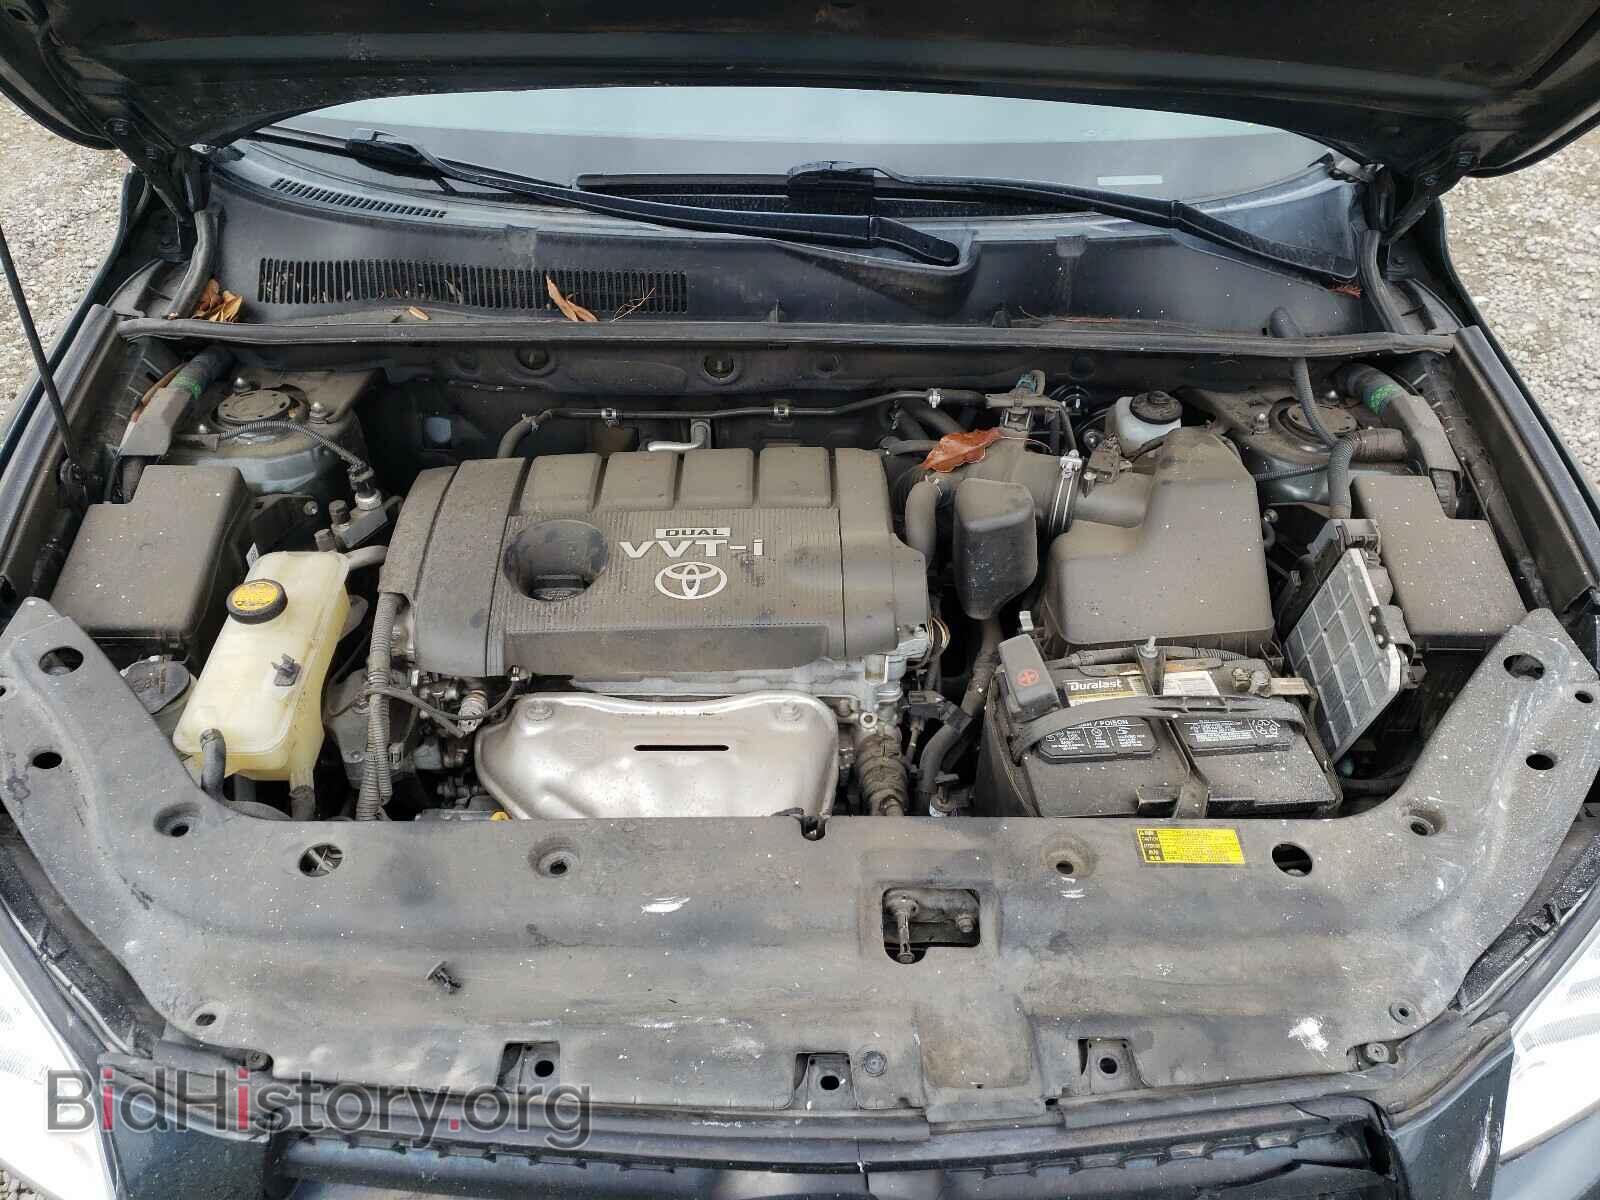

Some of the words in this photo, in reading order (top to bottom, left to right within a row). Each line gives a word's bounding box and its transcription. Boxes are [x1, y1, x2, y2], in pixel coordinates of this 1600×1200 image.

[665, 529, 725, 537] DUAL
[618, 539, 764, 559] VVT-i
[1067, 679, 1122, 691] Duralast
